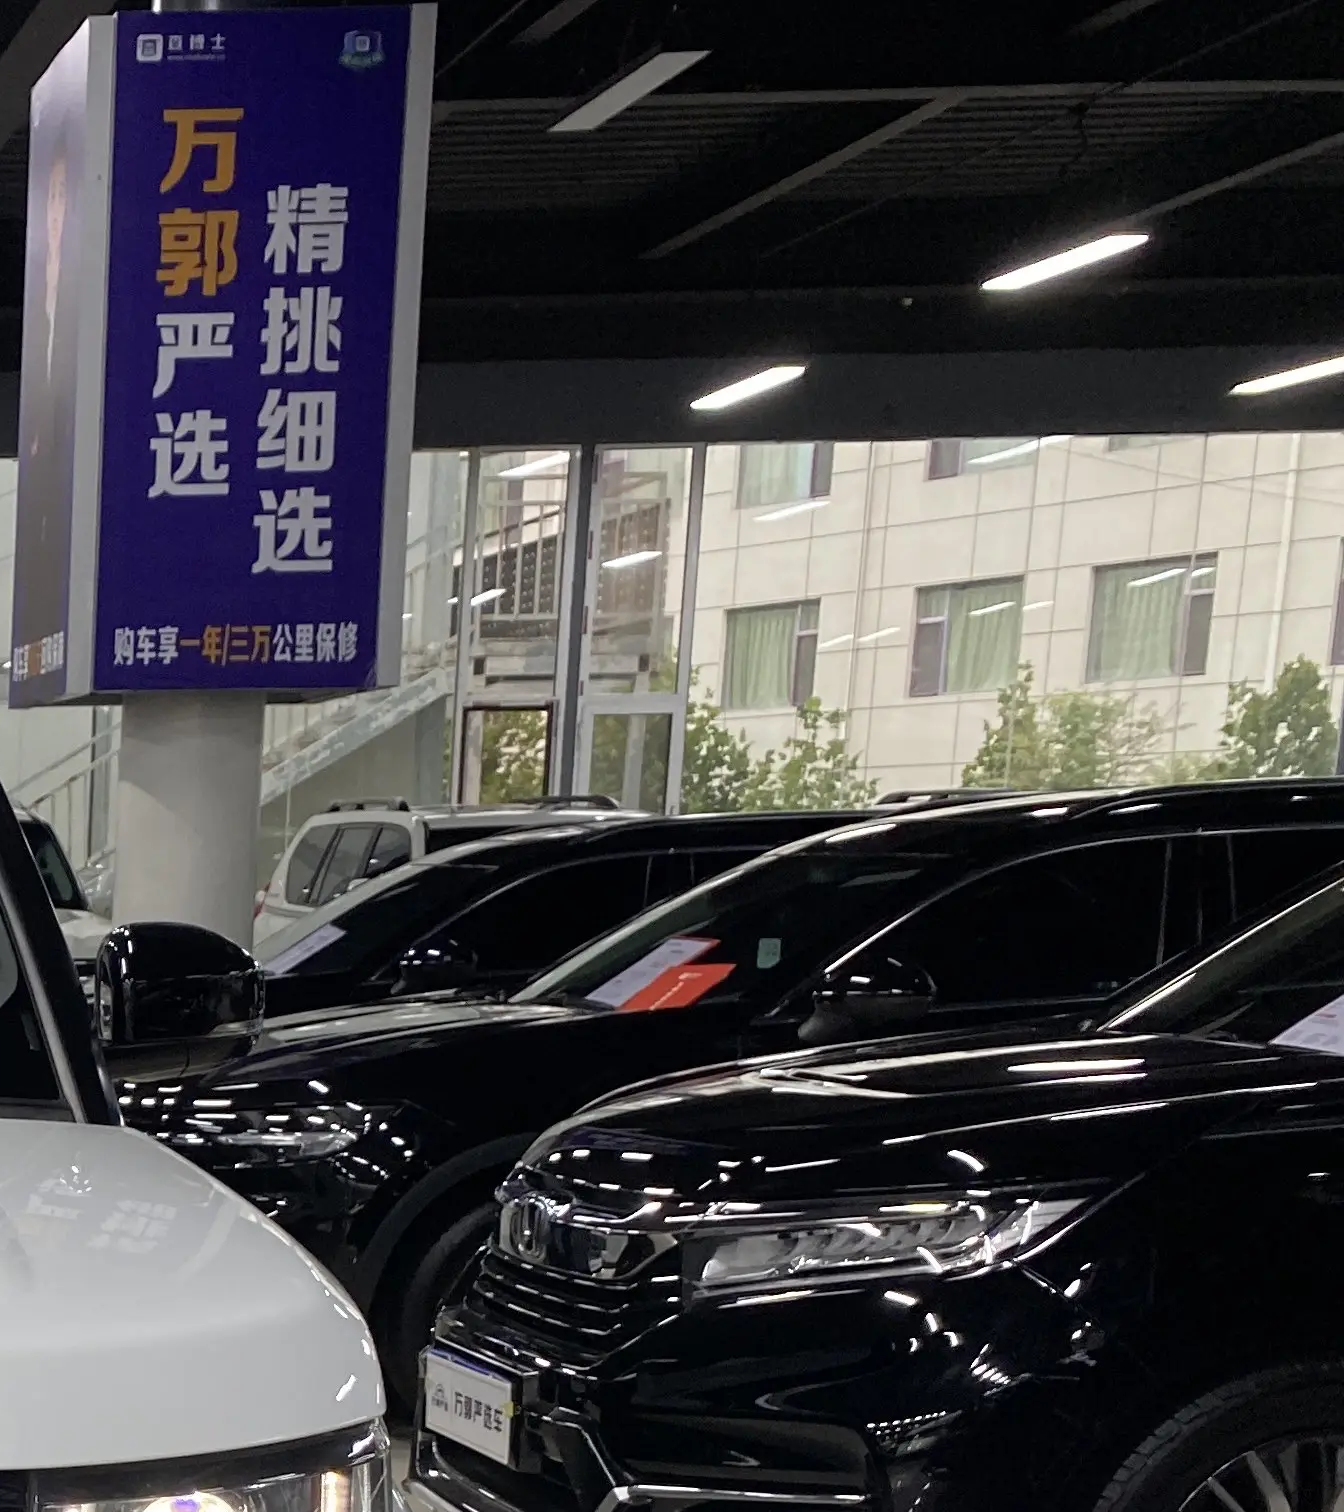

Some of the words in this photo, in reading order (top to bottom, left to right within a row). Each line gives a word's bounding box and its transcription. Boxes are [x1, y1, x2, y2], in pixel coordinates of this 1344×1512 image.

[148, 107, 244, 499] 万郭严选
[251, 183, 348, 574] 精挑细选
[113, 621, 359, 667] 购车享一年/三万公里保修
